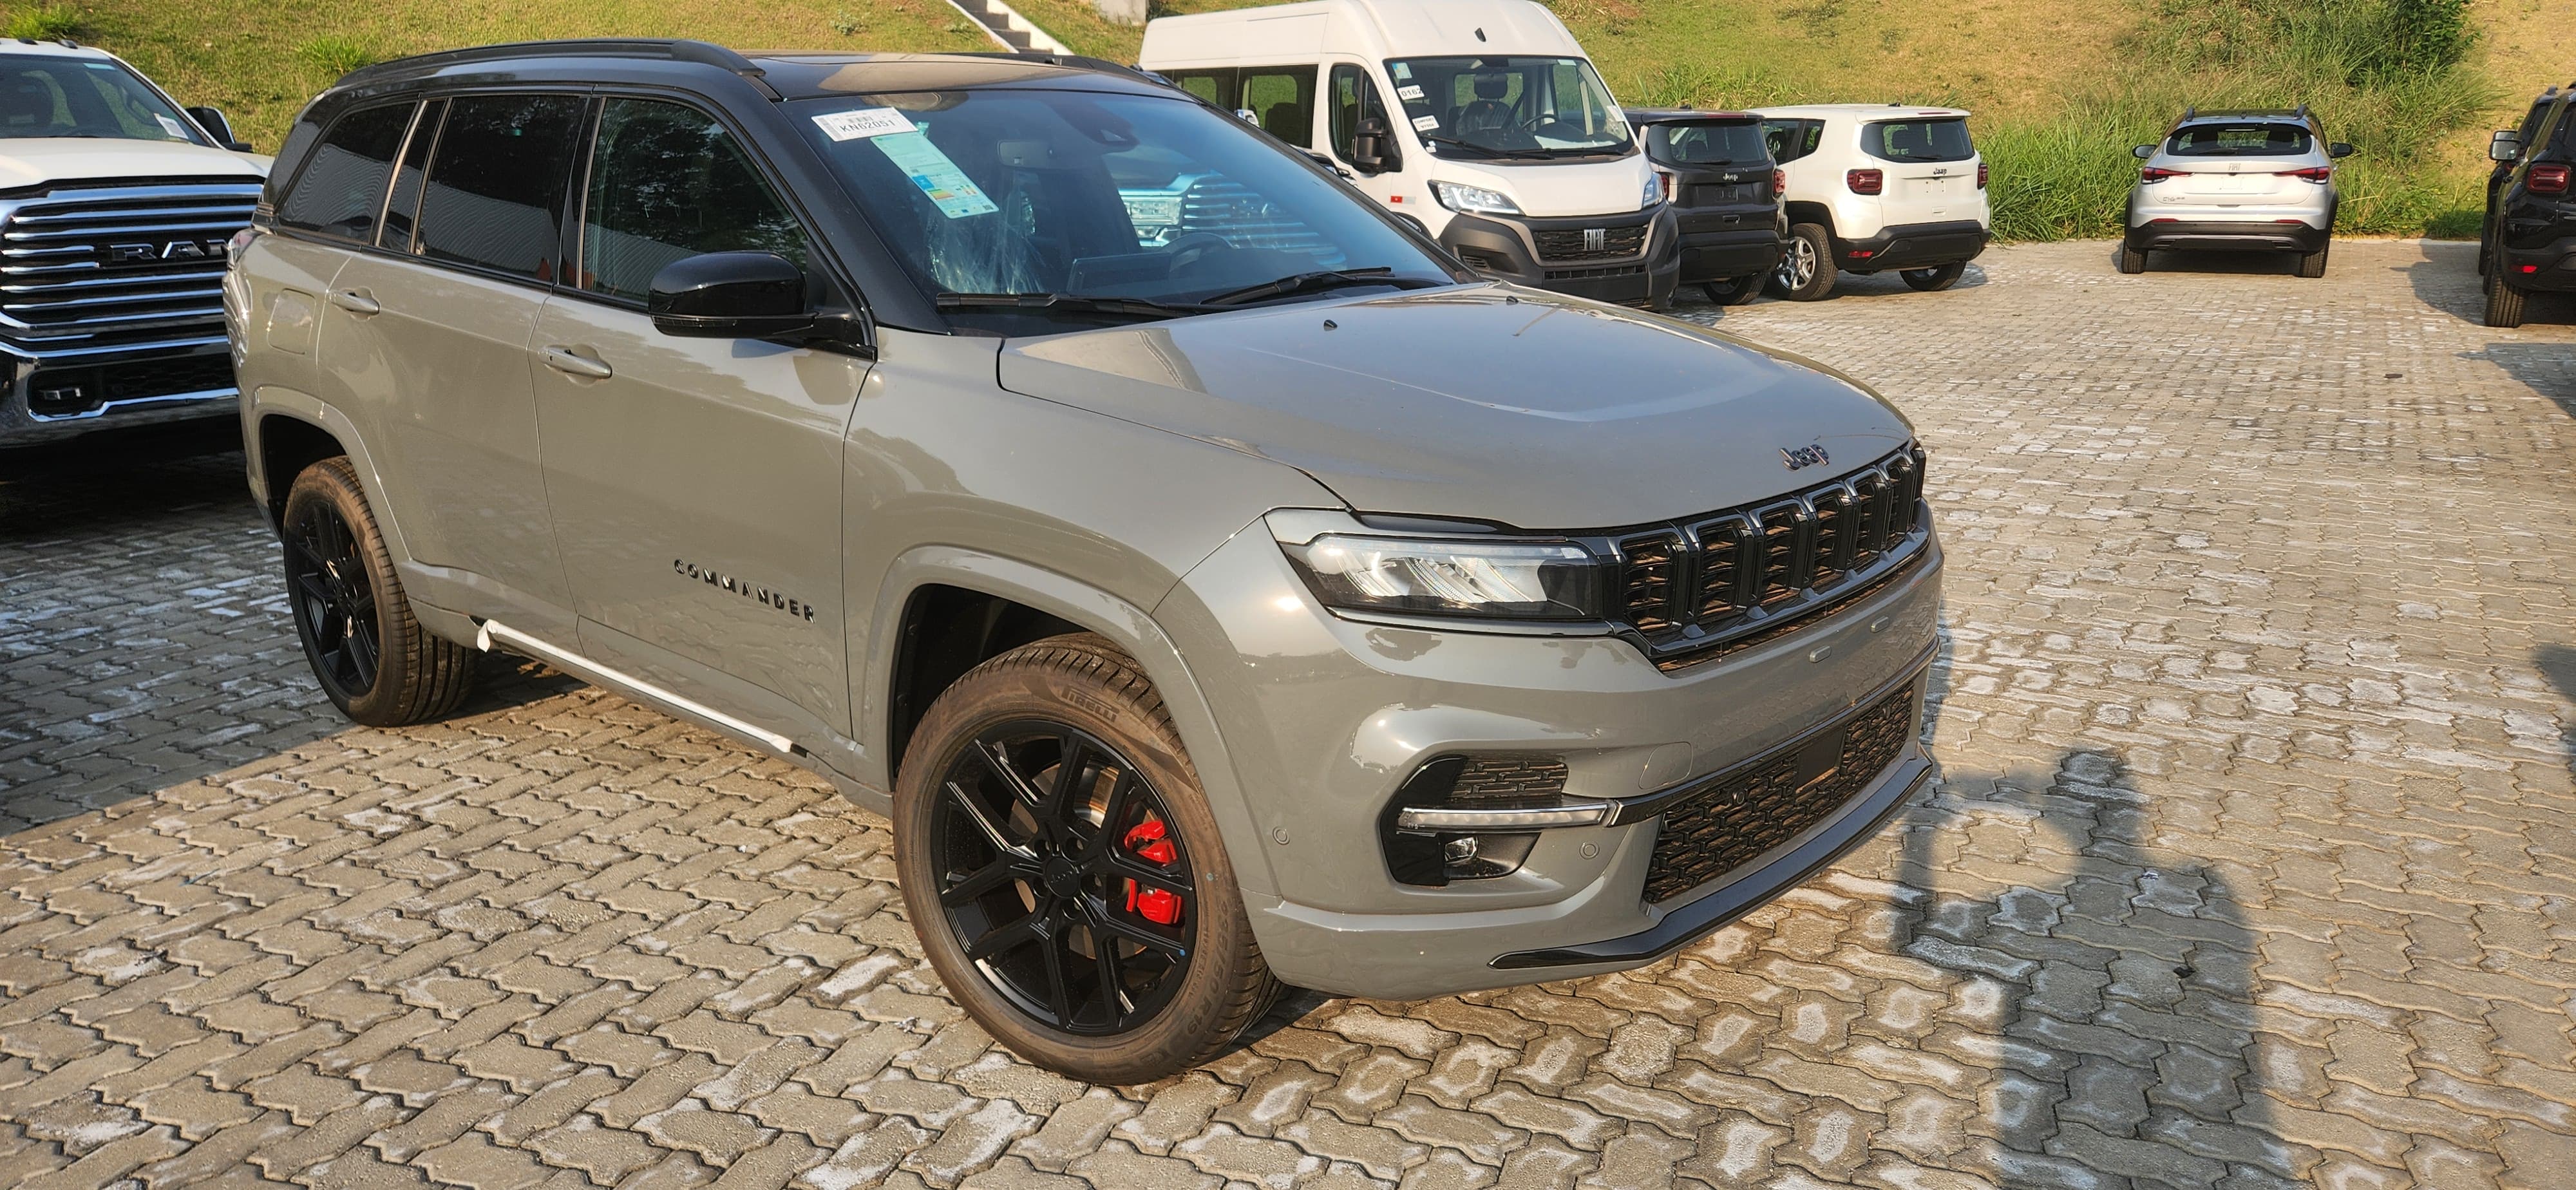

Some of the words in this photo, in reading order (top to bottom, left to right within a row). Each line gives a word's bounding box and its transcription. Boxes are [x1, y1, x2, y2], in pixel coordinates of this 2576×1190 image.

[840, 119, 896, 132] KN62051
[2228, 162, 2241, 171] FIAT
[1584, 228, 1605, 250] FIAT
[1778, 444, 1830, 471] Jeep
[674, 558, 816, 624] COMMANDER
[1061, 685, 1120, 722] PIRELLI
